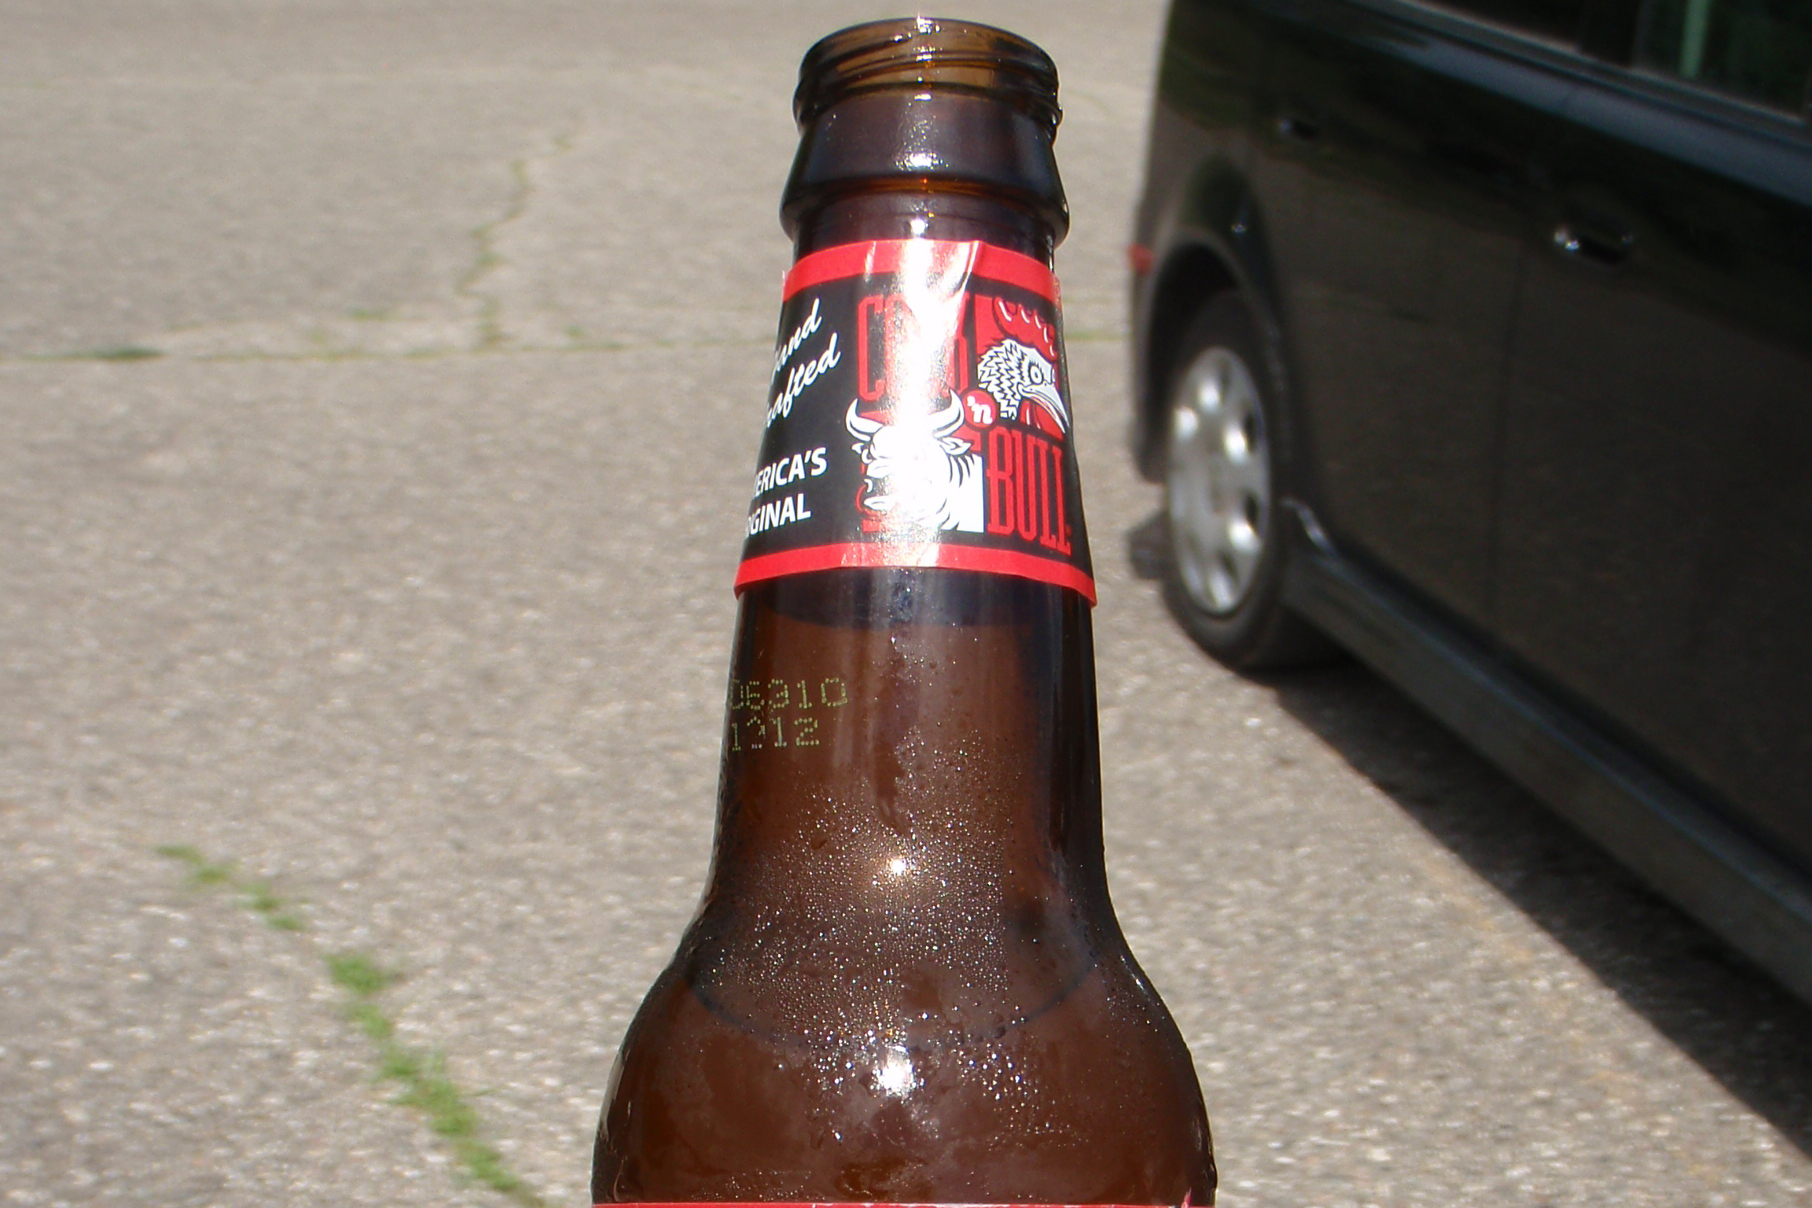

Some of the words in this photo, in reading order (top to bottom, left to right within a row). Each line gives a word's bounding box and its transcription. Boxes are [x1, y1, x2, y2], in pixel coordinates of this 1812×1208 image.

[764, 332, 841, 429] rafted
[771, 298, 822, 386] and
[754, 446, 829, 499] ERICA'S
[986, 427, 1072, 556] BULL
